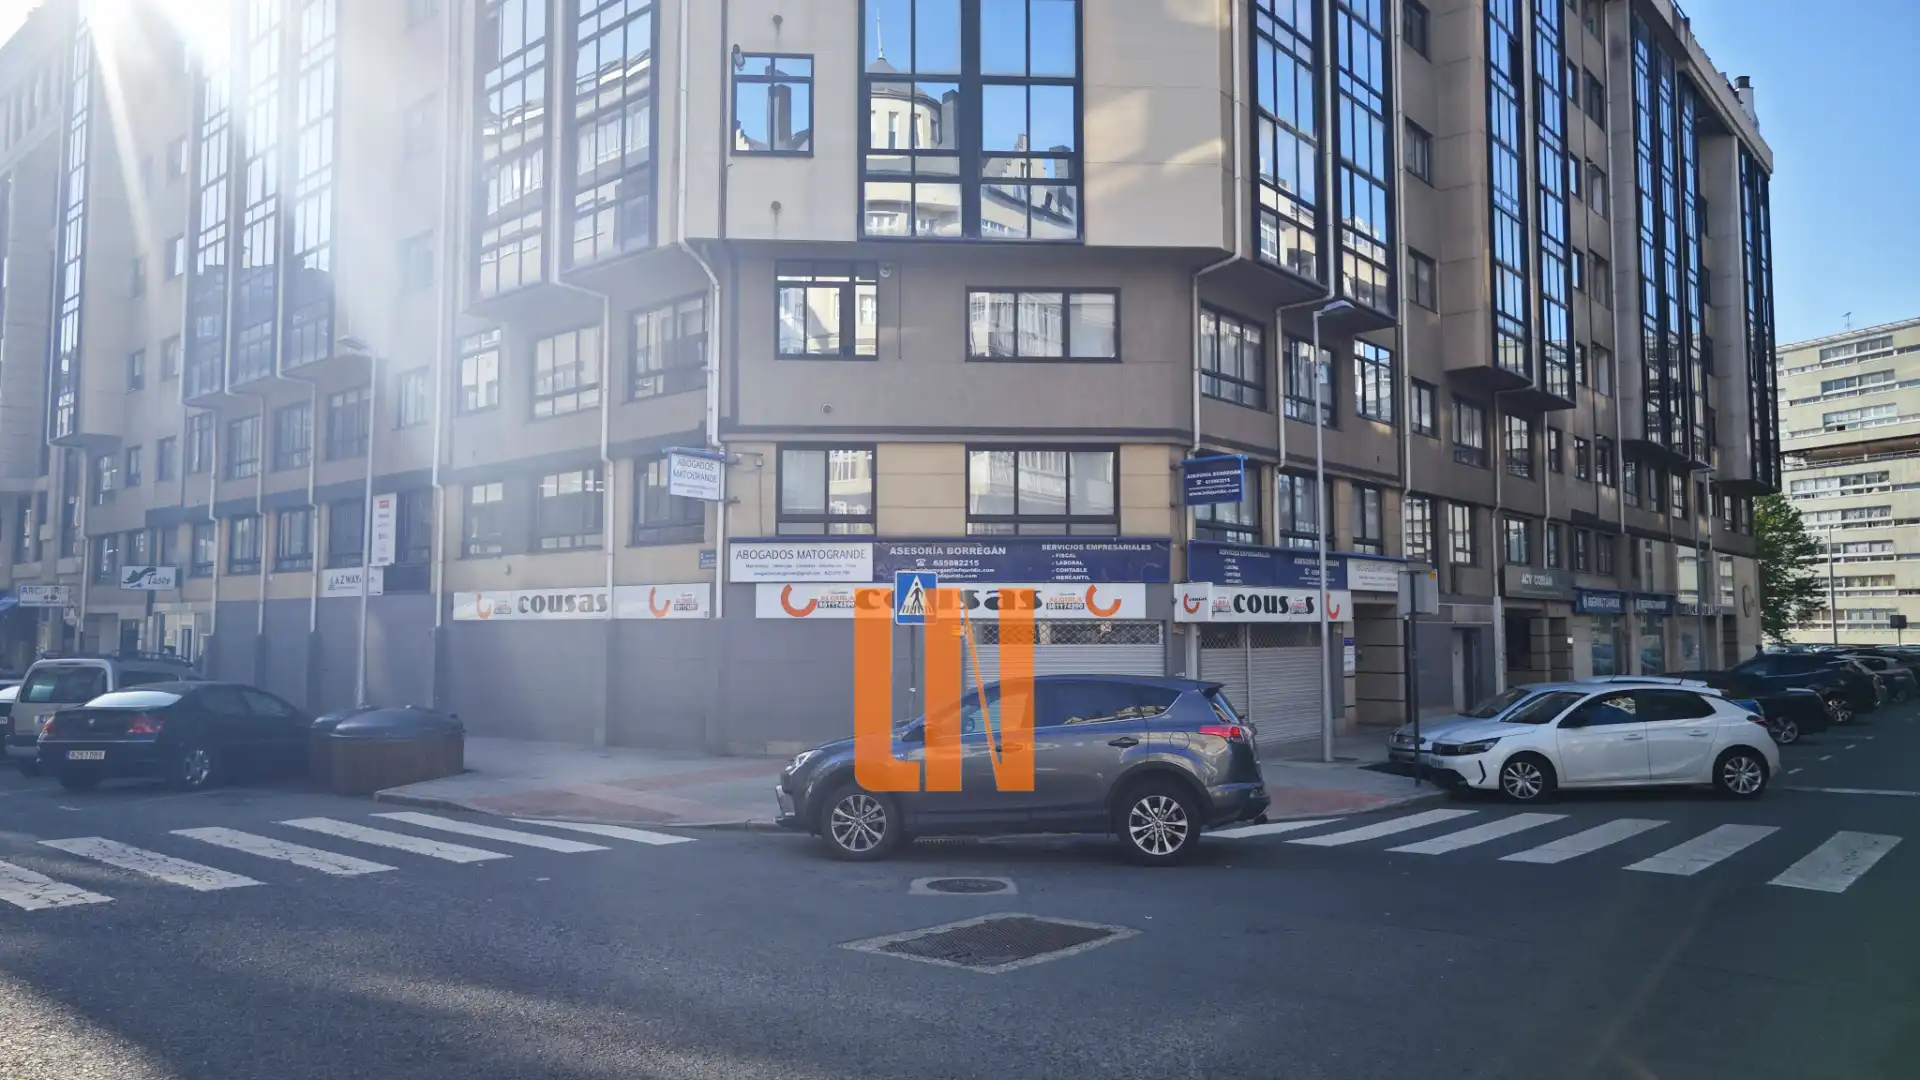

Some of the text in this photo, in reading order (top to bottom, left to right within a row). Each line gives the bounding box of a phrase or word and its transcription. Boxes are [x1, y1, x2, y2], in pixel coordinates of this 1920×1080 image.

[889, 544, 1006, 555] ASESORÍA BORREGÁN
[1041, 543, 1152, 551] SERVICIOS EMPRESARIALES
[736, 549, 866, 560] ABOGADOS MATOGRANDE
[518, 593, 609, 614] cousas
[1233, 593, 1315, 615] couss
